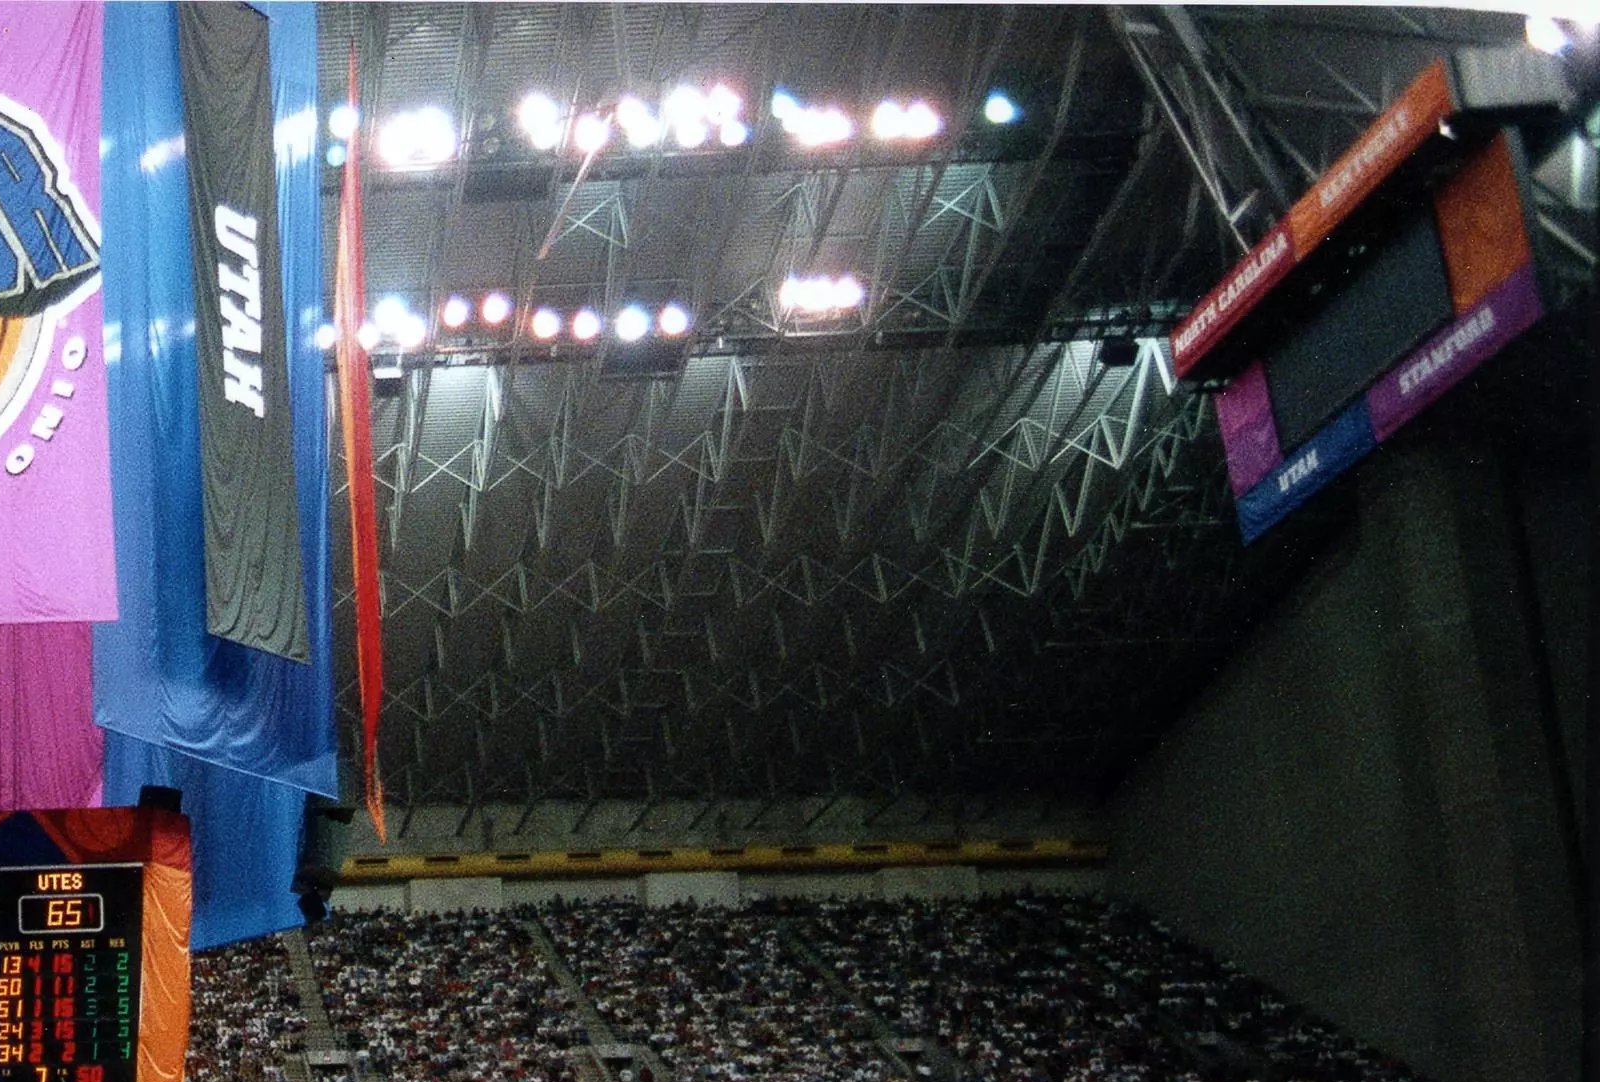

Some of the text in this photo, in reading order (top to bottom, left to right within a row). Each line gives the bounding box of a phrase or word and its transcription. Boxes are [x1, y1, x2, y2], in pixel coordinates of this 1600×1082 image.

[215, 204, 264, 418] UTAH
[38, 874, 83, 891] UTES
[47, 900, 83, 927] 65
[52, 939, 70, 950] PTS
[2, 956, 22, 974] 13
[116, 952, 129, 971] 2
[117, 975, 129, 993] 2
[117, 997, 130, 1015] 5
